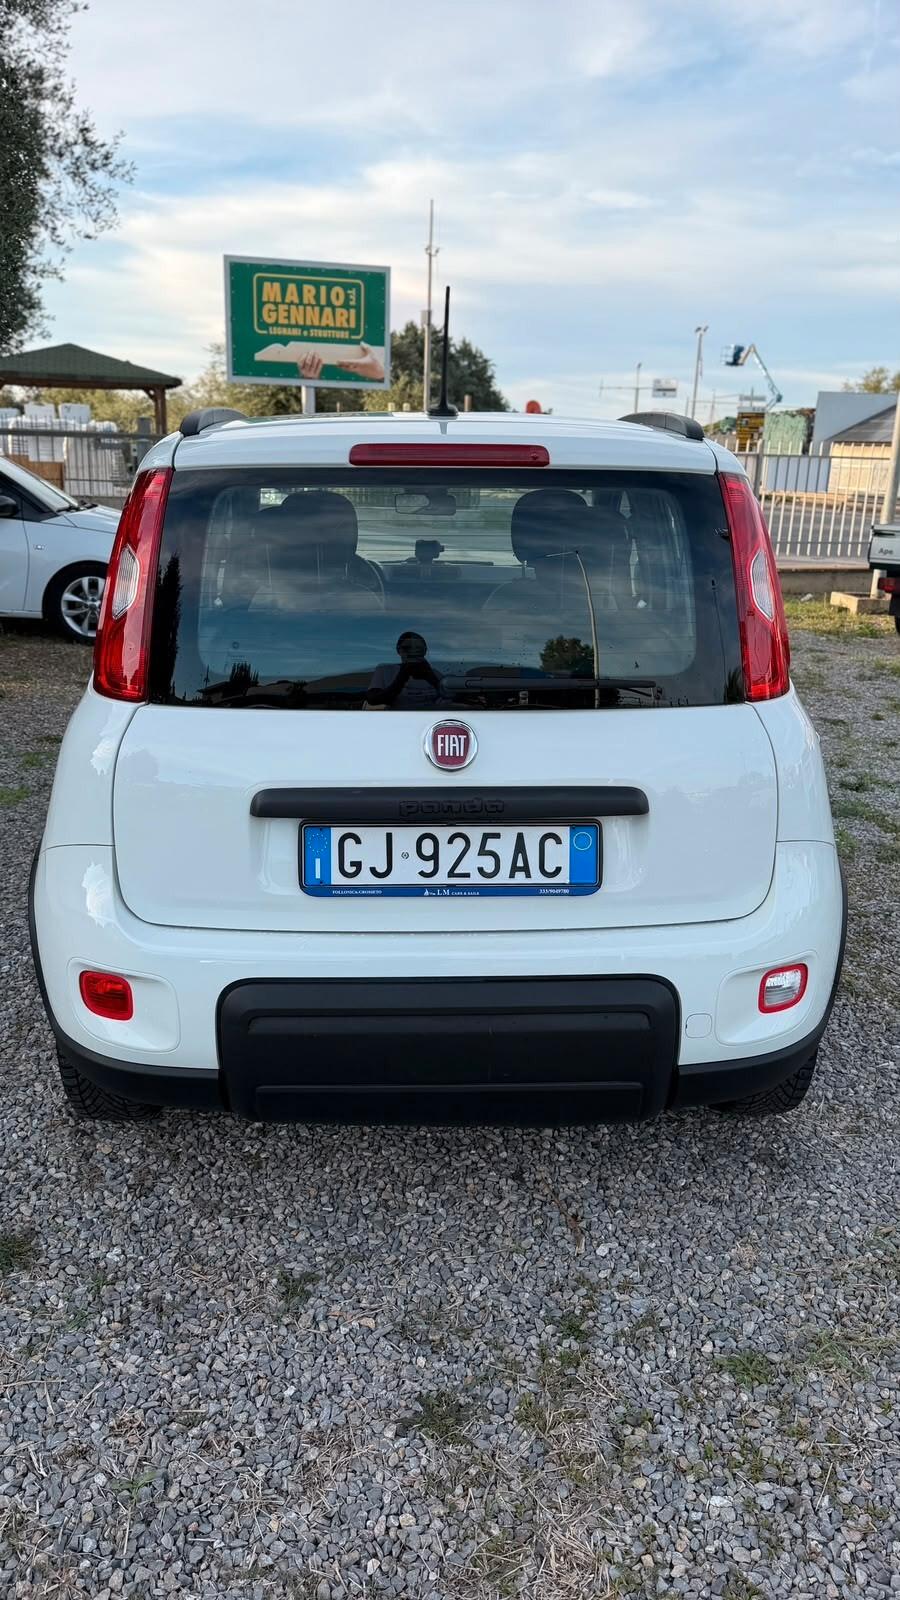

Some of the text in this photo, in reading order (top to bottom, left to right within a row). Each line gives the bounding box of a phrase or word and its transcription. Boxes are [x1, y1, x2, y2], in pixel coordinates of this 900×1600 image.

[262, 281, 345, 306] MARIO
[262, 303, 356, 328] GENNARI
[878, 547, 893, 555] Ape
[437, 734, 467, 757] FIAT
[399, 797, 505, 817] panda
[337, 831, 563, 879] GJ 925AC
